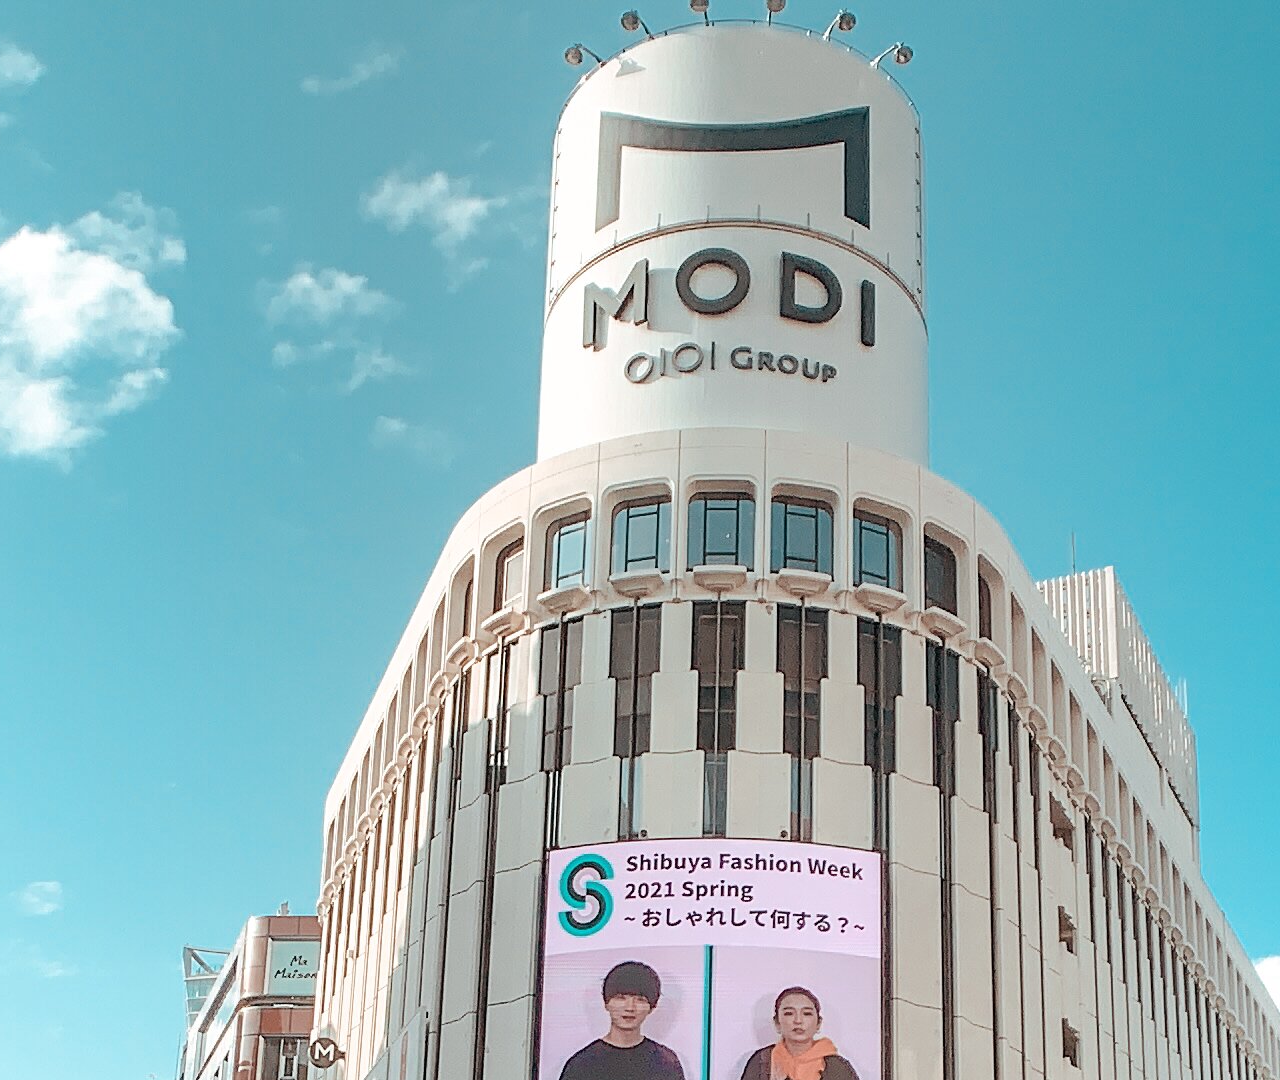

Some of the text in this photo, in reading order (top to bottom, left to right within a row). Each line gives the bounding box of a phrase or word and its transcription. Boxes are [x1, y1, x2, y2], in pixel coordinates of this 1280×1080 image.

[582, 247, 875, 352] MODI
[729, 346, 838, 383] GROUP
[626, 853, 864, 881] Shibuya Fashion Week
[625, 881, 753, 902] 2021 Spring
[274, 967, 318, 979] Maison
